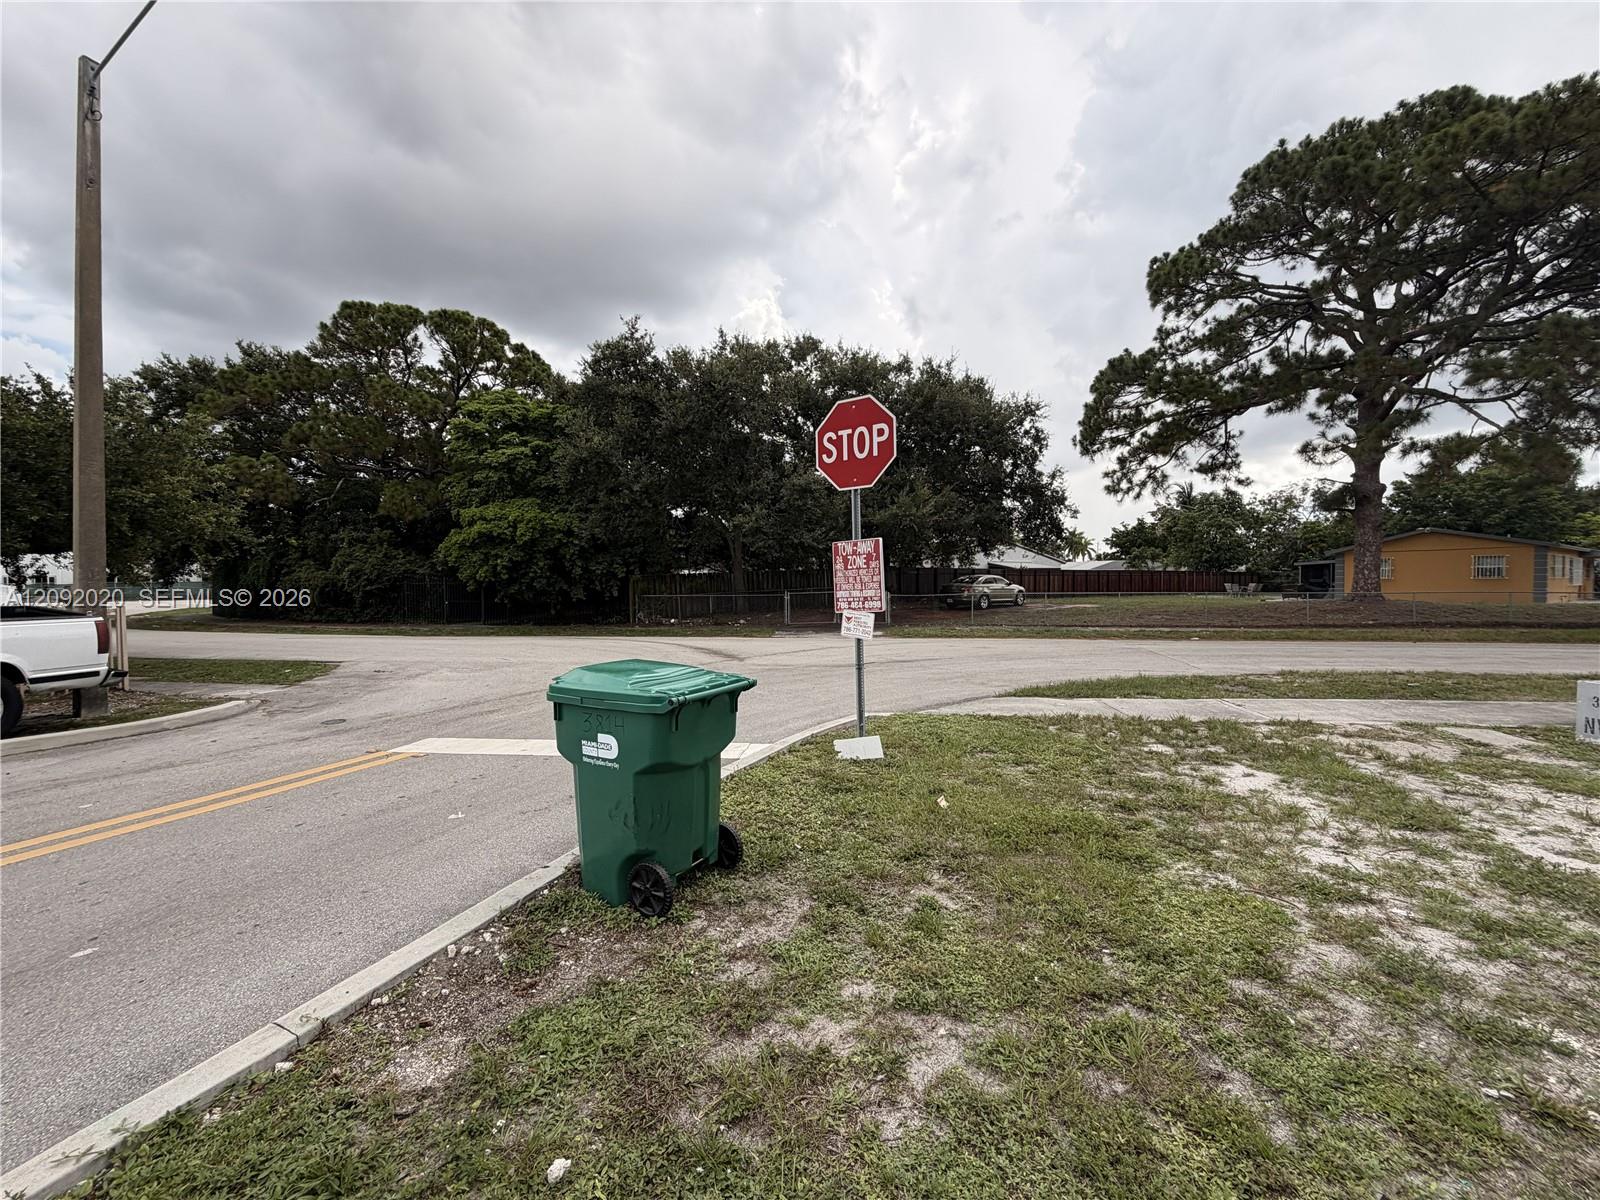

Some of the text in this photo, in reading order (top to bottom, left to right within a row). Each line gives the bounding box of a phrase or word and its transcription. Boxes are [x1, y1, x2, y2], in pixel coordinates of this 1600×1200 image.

[822, 422, 889, 464] STOP
[837, 540, 875, 556] TOW-AWAY
[847, 555, 867, 569] ZONE
